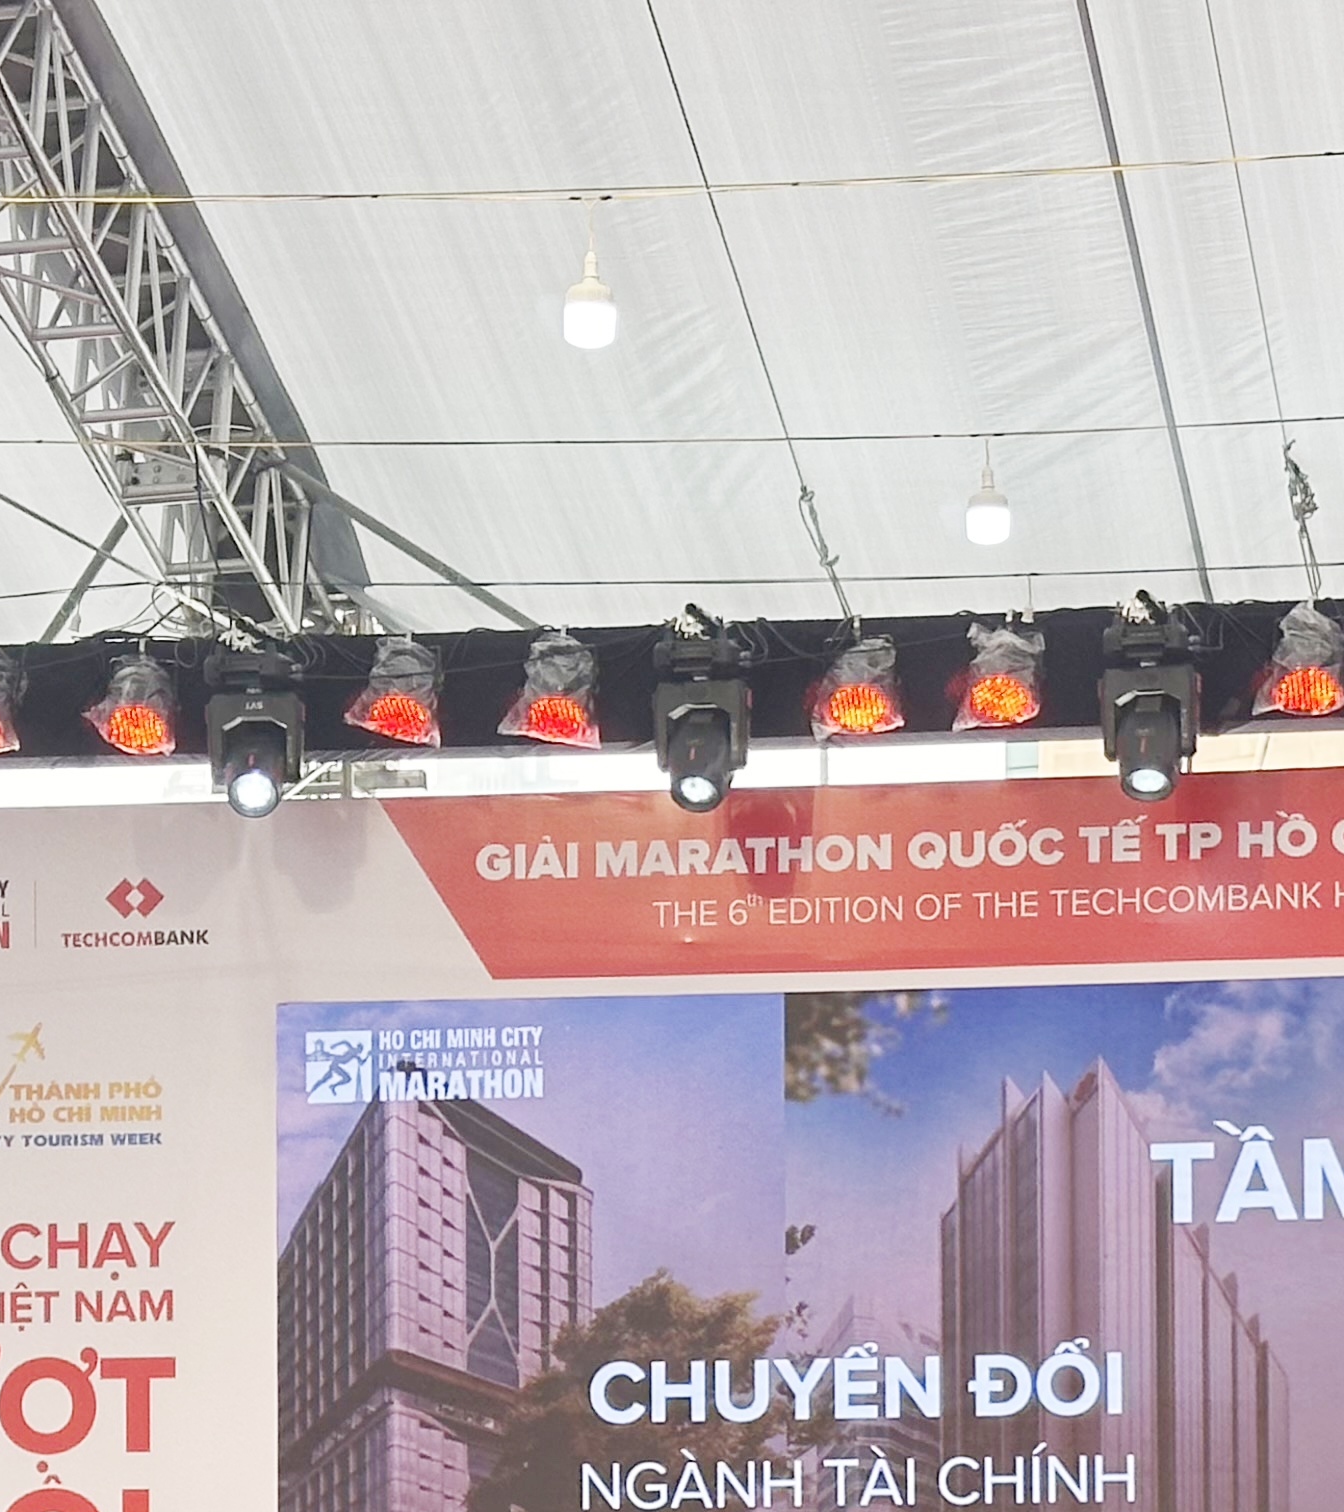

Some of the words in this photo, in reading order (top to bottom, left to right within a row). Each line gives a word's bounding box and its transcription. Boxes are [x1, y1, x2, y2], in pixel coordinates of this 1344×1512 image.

[474, 834, 579, 882] GIẢI
[594, 832, 893, 879] MARATHON
[906, 818, 1065, 872] QUỐC
[1078, 814, 1149, 864] TẾ
[1155, 821, 1222, 862] TP
[1237, 809, 1319, 859] HỒ
[652, 900, 718, 929] THE
[769, 894, 903, 926] EDITION
[914, 893, 962, 921] OF
[972, 890, 1039, 919] THE
[1049, 881, 1322, 917] TECHCOMBANK
[61, 929, 209, 948] TECHCOMBANK
[378, 1029, 405, 1051] HO
[410, 1028, 441, 1050] CHI
[446, 1027, 495, 1049] MINH
[500, 1026, 544, 1048] CITY
[378, 1050, 543, 1069] INTERNATIONAL
[378, 1068, 544, 1102] MARATHON
[100, 1104, 162, 1121] MINH
[23, 1133, 104, 1148] TOURISM
[111, 1132, 162, 1146] WEEK
[0, 1220, 176, 1281] CHẠY
[75, 1289, 174, 1323] NAM
[588, 1342, 942, 1425] CHUYỂN
[967, 1336, 1125, 1419] ĐỔI
[580, 1448, 804, 1512] NGÀNH
[822, 1444, 917, 1507] TÀI
[938, 1441, 1137, 1506] CHÍNH
